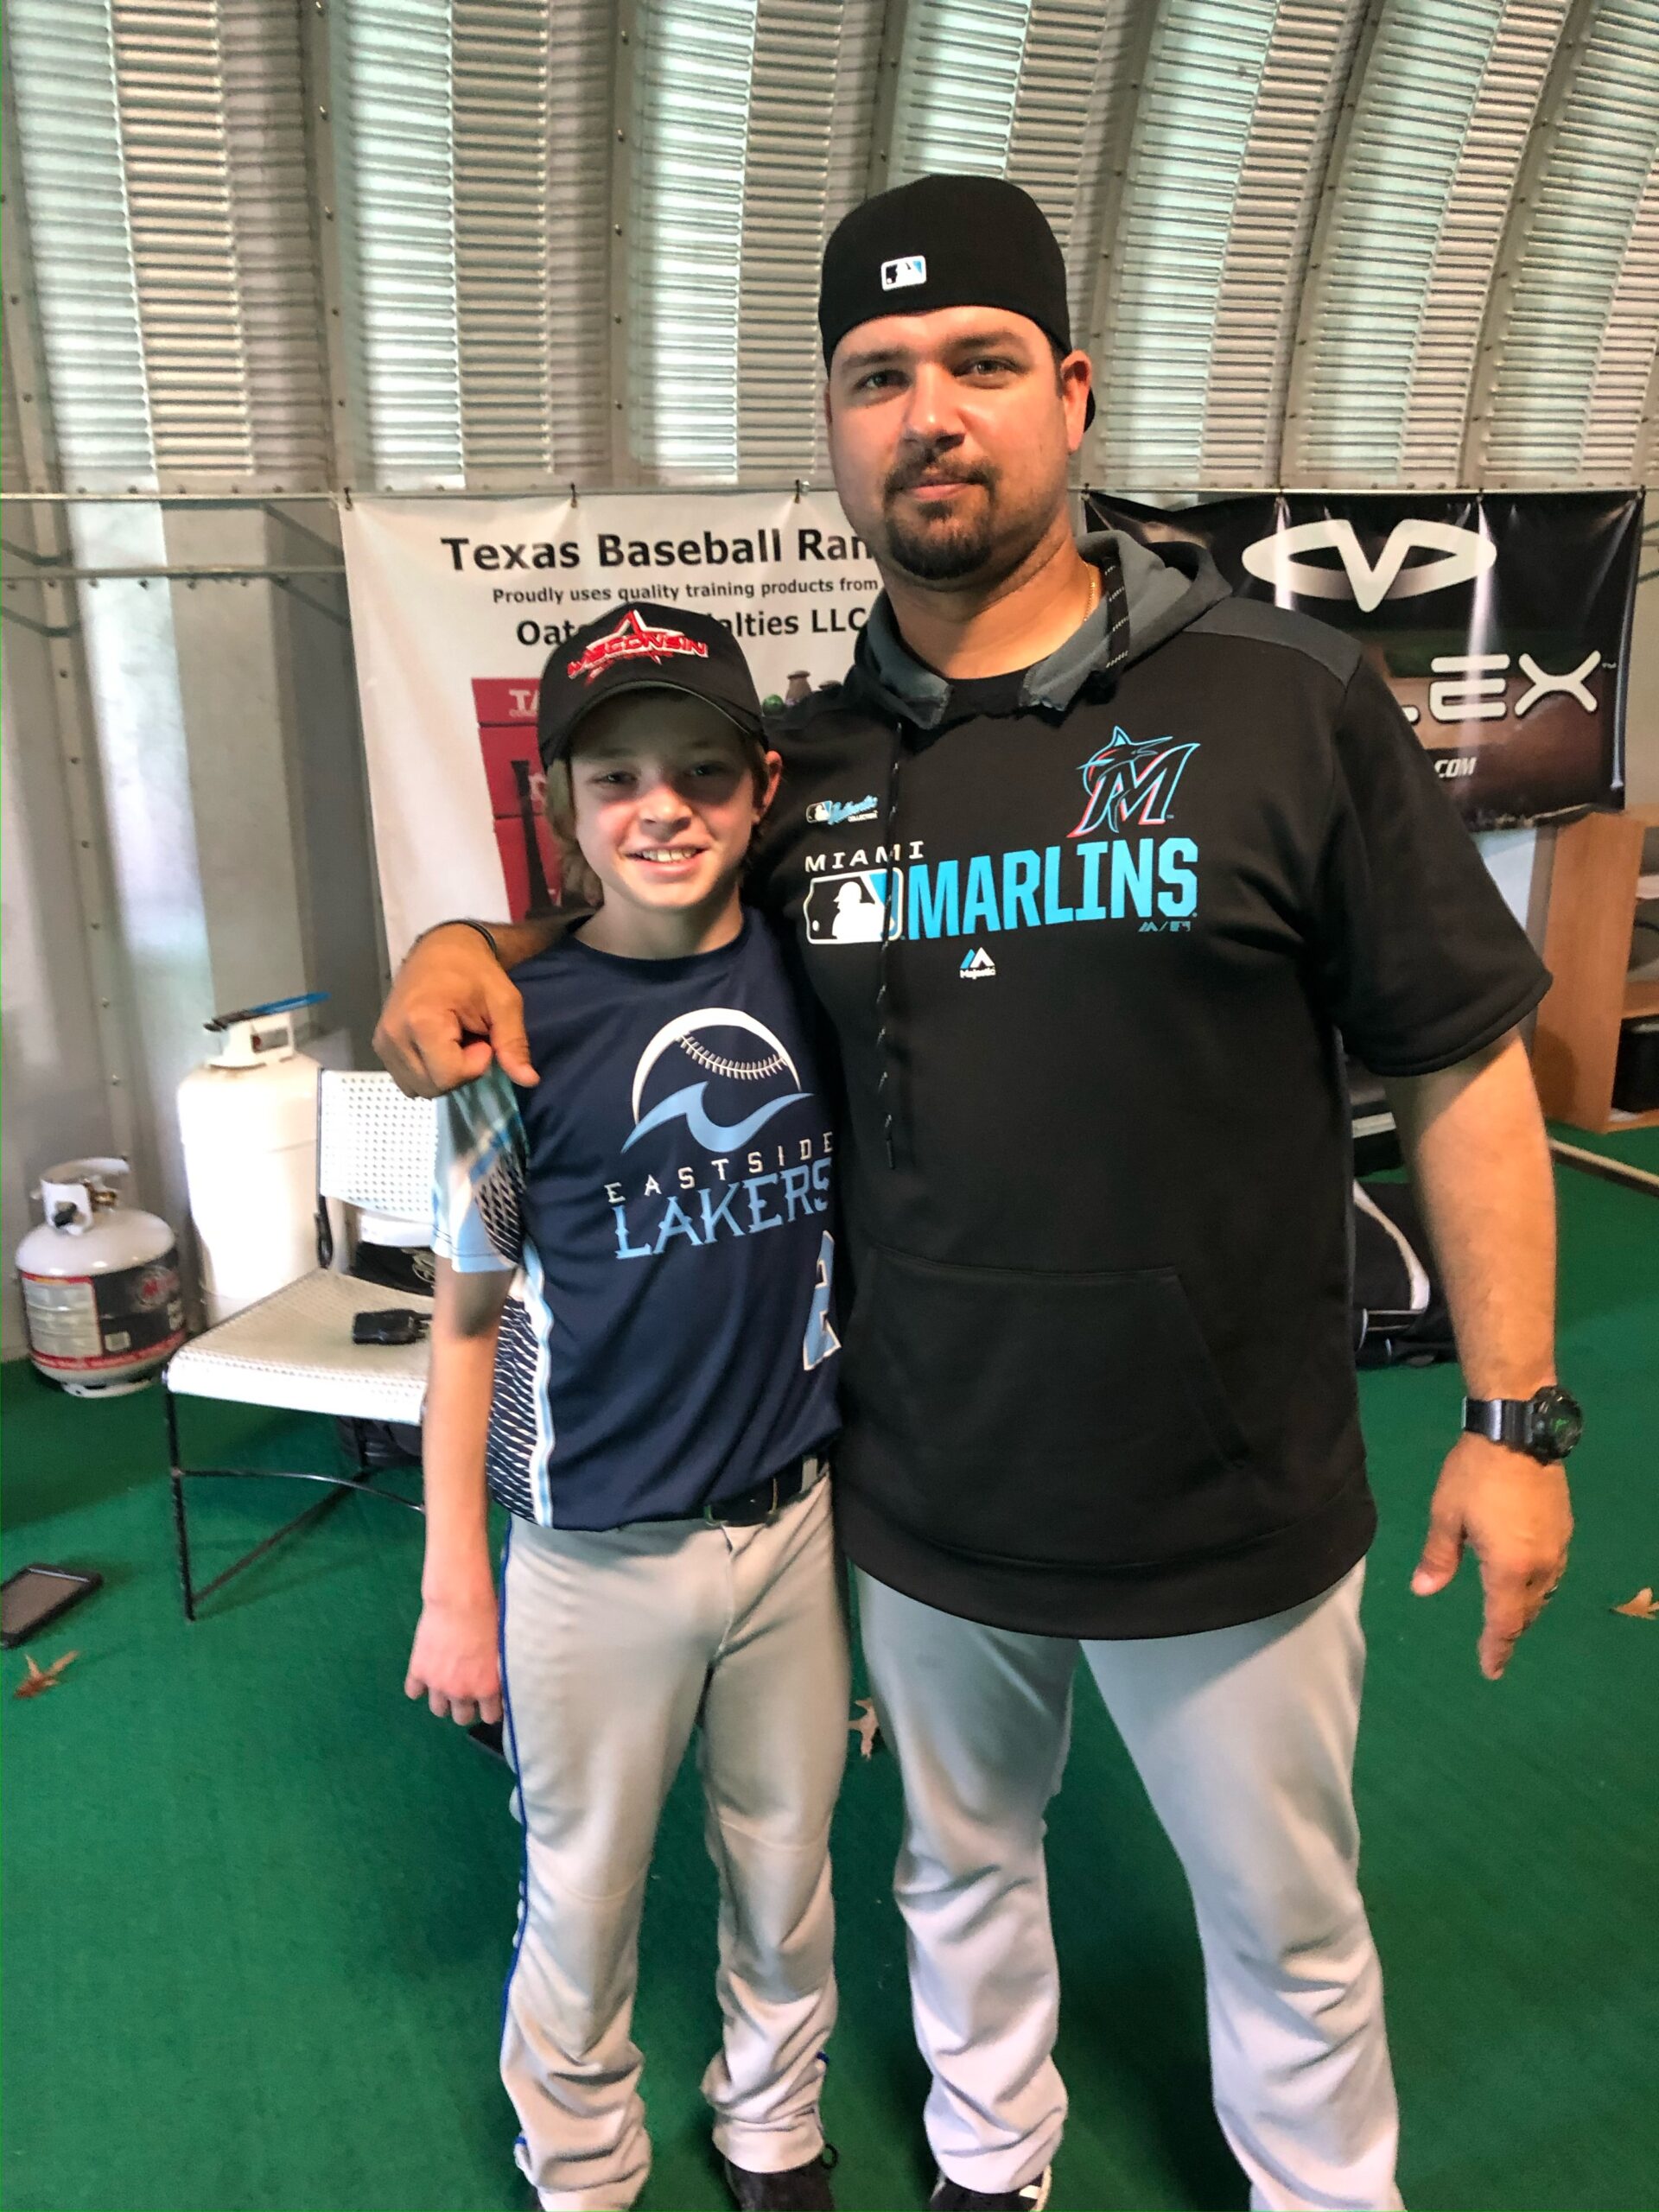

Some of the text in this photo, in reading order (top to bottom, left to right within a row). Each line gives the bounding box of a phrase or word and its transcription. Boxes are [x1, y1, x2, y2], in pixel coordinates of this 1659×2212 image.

[440, 528, 875, 571] Texas Baseball Ran
[492, 577, 879, 605] Proudly uses quality training products from
[516, 619, 582, 646] Oat
[810, 607, 867, 633] LLC
[1402, 650, 1601, 722] EX
[804, 840, 925, 873] MIAMI
[908, 836, 1199, 942] MARLINS
[604, 1130, 833, 1205] EASTSIDE
[612, 1158, 832, 1260] LAKERS
